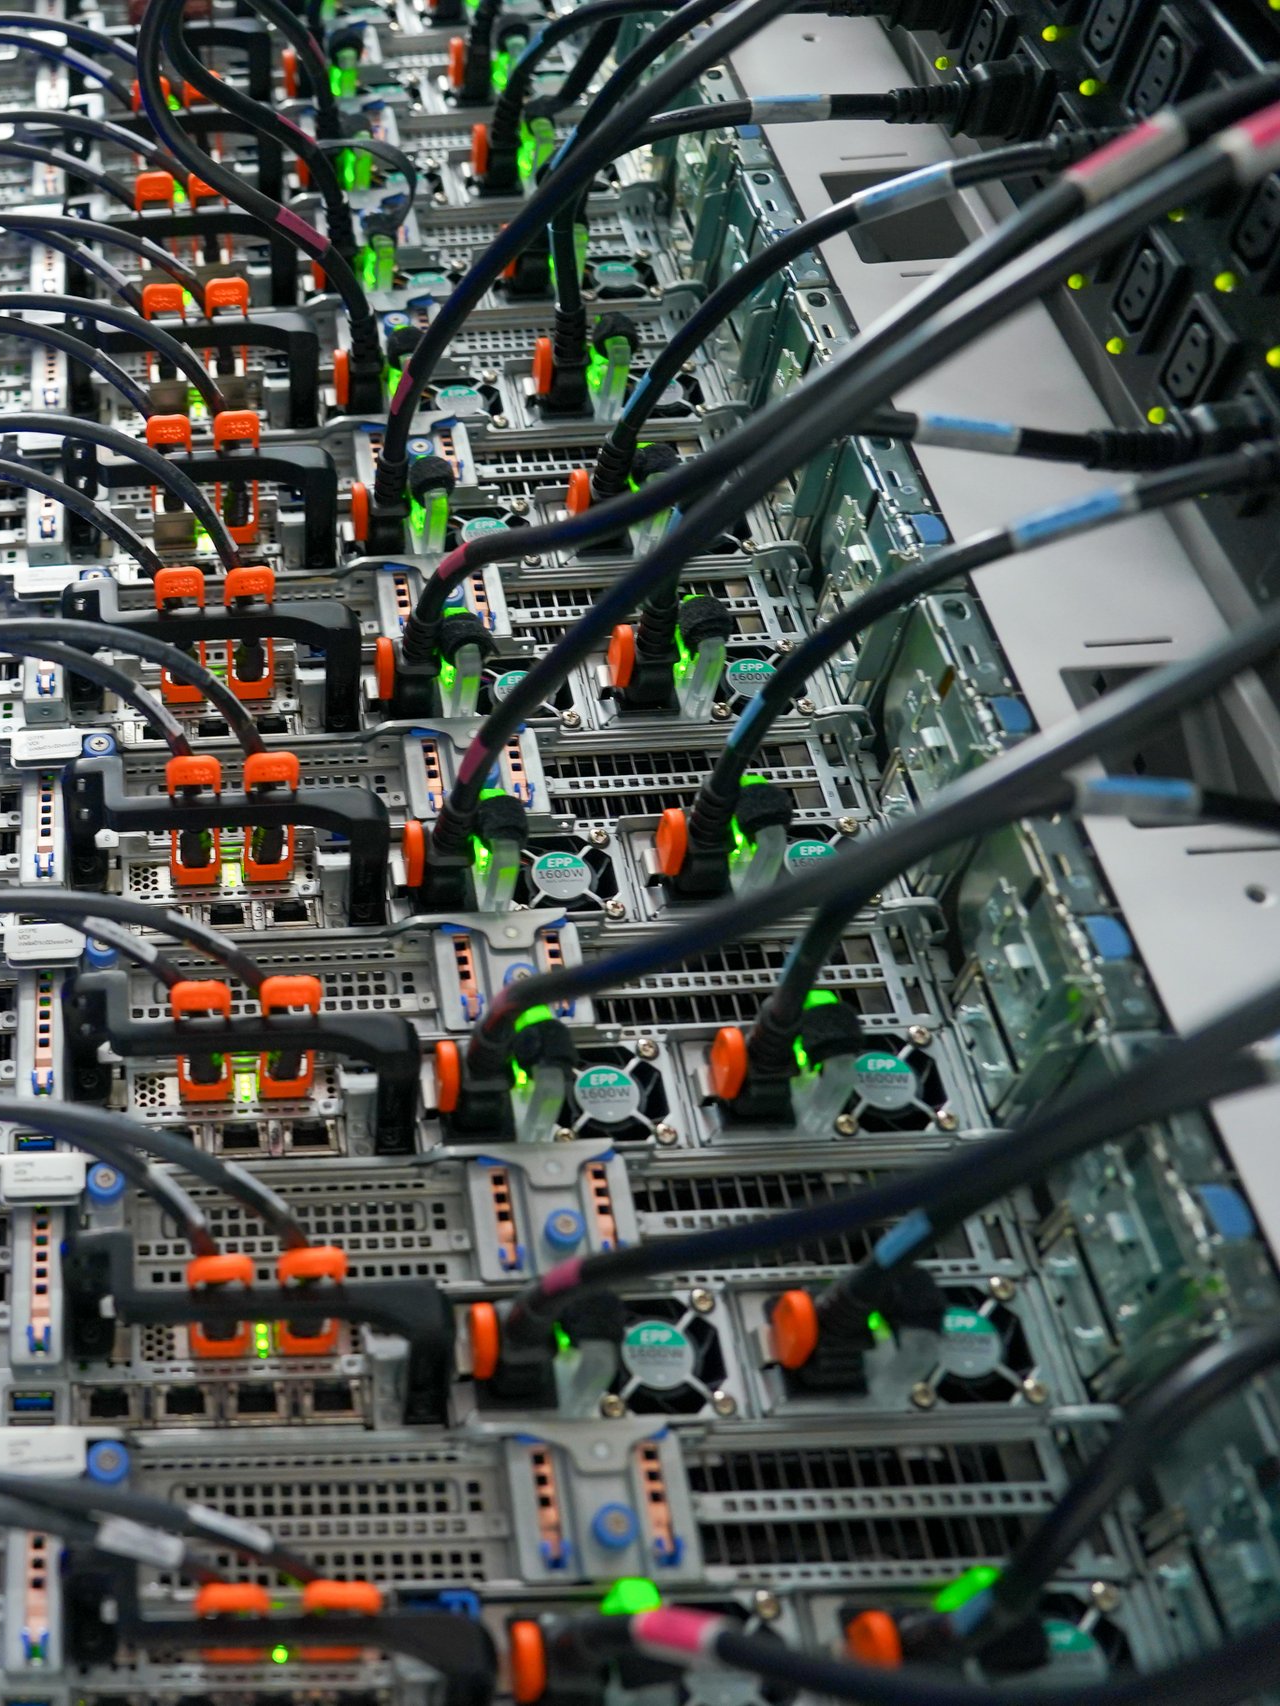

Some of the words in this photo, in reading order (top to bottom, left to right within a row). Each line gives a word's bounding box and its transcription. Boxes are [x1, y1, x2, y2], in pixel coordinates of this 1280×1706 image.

[739, 663, 764, 671] EPP
[799, 845, 826, 856] EPP
[547, 857, 573, 868] EPP
[538, 868, 584, 879] 1600W
[867, 1059, 896, 1071] EPP
[590, 1073, 618, 1085] EPP
[580, 1087, 630, 1099] 1600W
[640, 1329, 672, 1343] EPP
